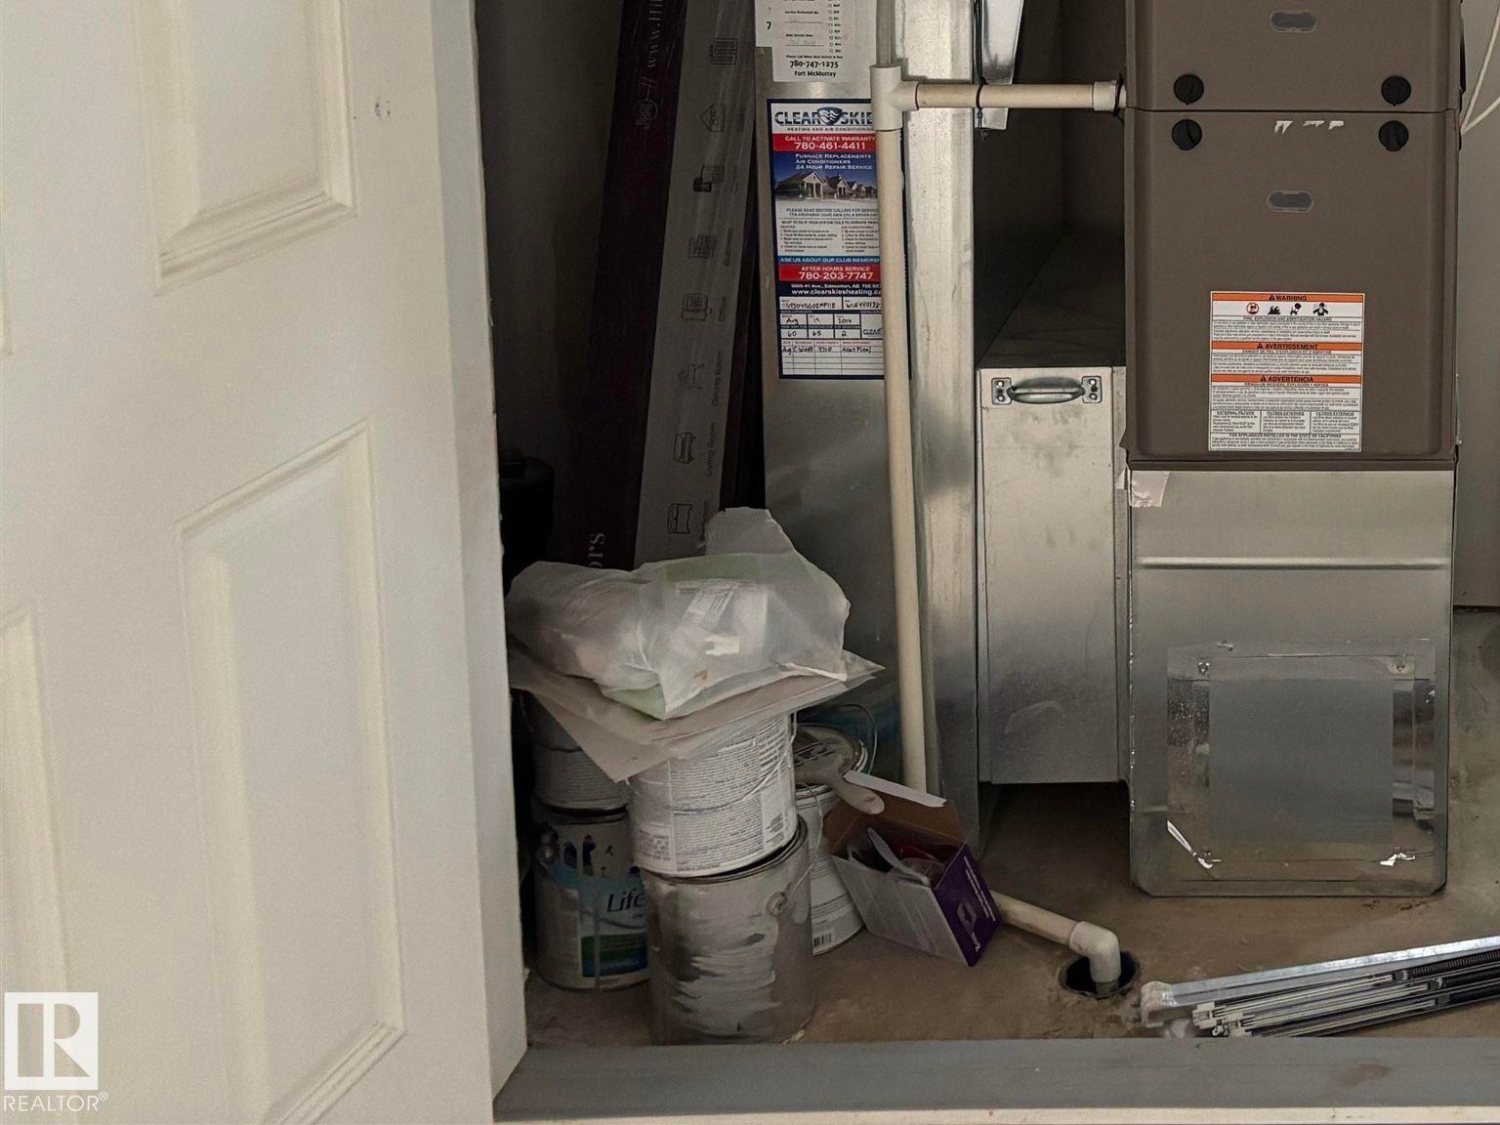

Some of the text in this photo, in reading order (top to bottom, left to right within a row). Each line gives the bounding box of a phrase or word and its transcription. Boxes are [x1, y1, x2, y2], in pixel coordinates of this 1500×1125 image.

[790, 60, 839, 69] 780-747-1275
[774, 112, 821, 125] CLEAR
[794, 142, 867, 151] 780-461-4411
[798, 272, 873, 280] 780-203-7747
